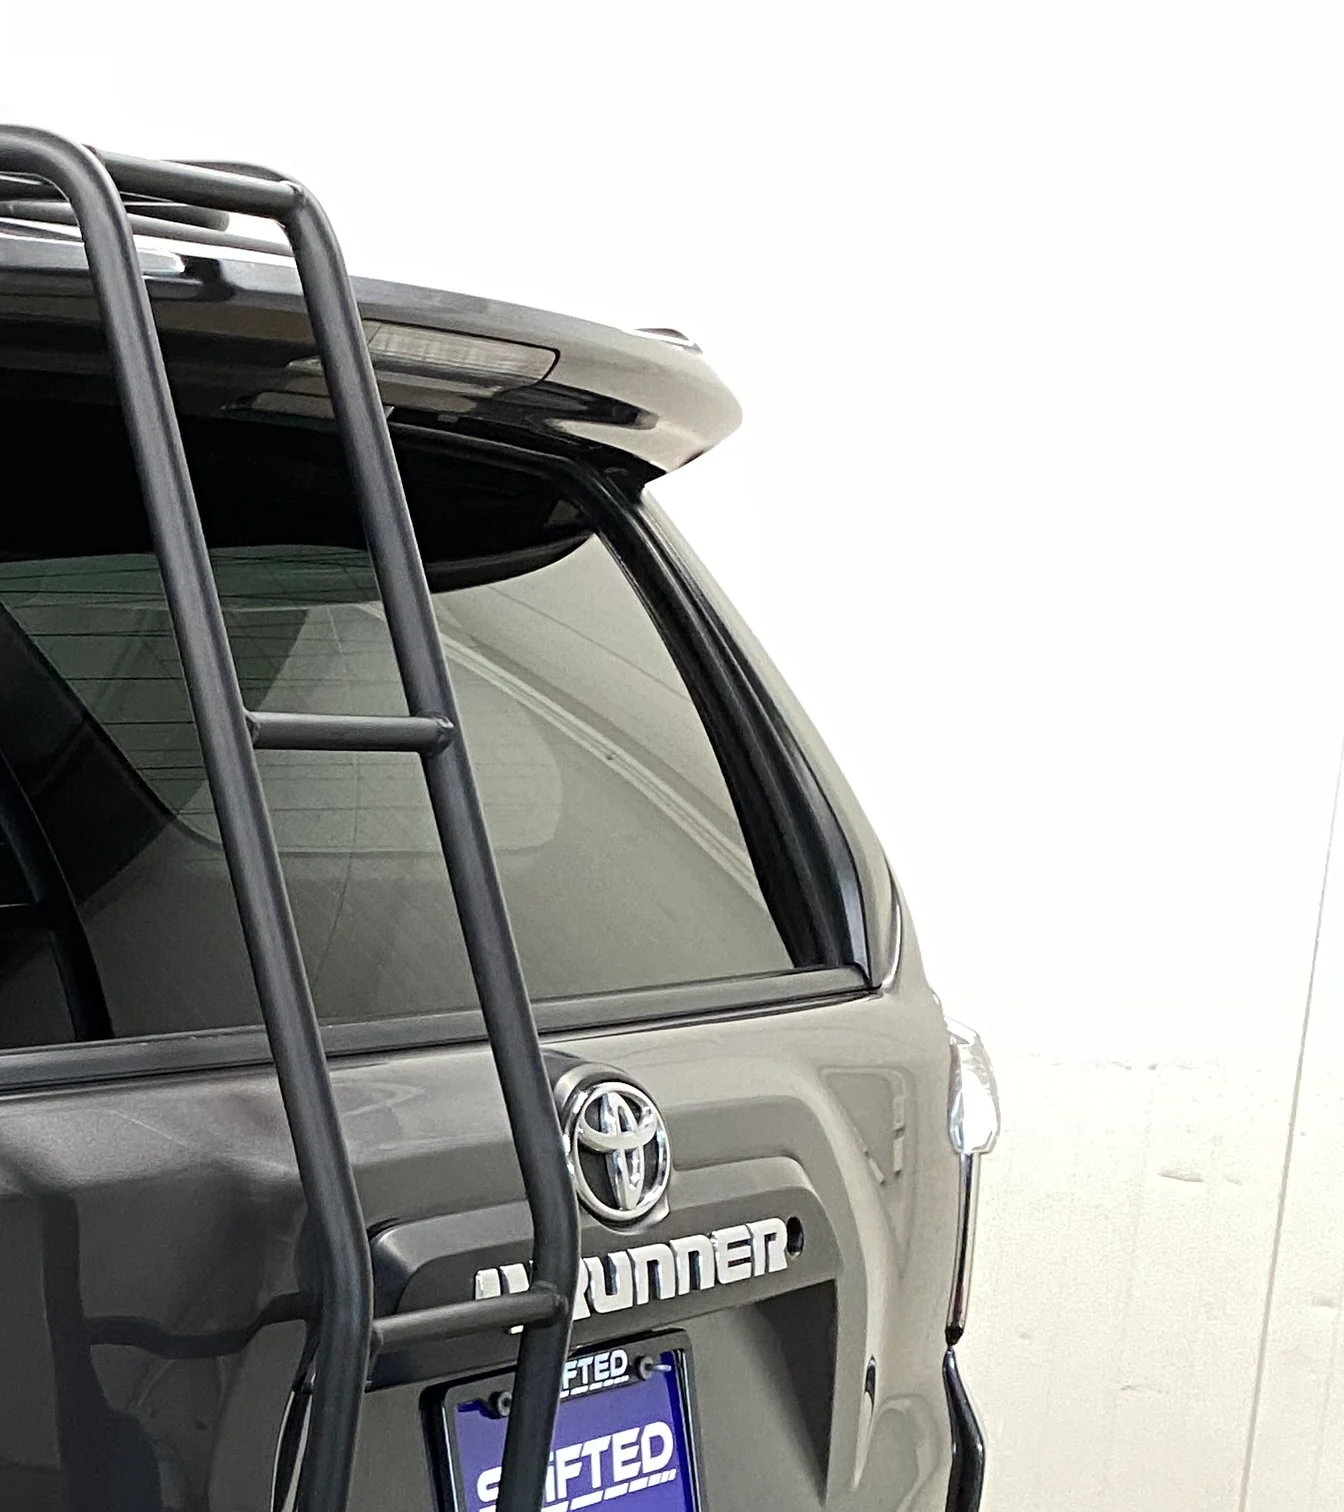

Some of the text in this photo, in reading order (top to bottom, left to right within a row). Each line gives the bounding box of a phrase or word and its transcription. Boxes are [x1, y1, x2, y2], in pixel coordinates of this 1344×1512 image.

[475, 1217, 788, 1335] UNNER
[561, 1349, 628, 1390] FTED
[477, 1421, 674, 1503] SIFTED
